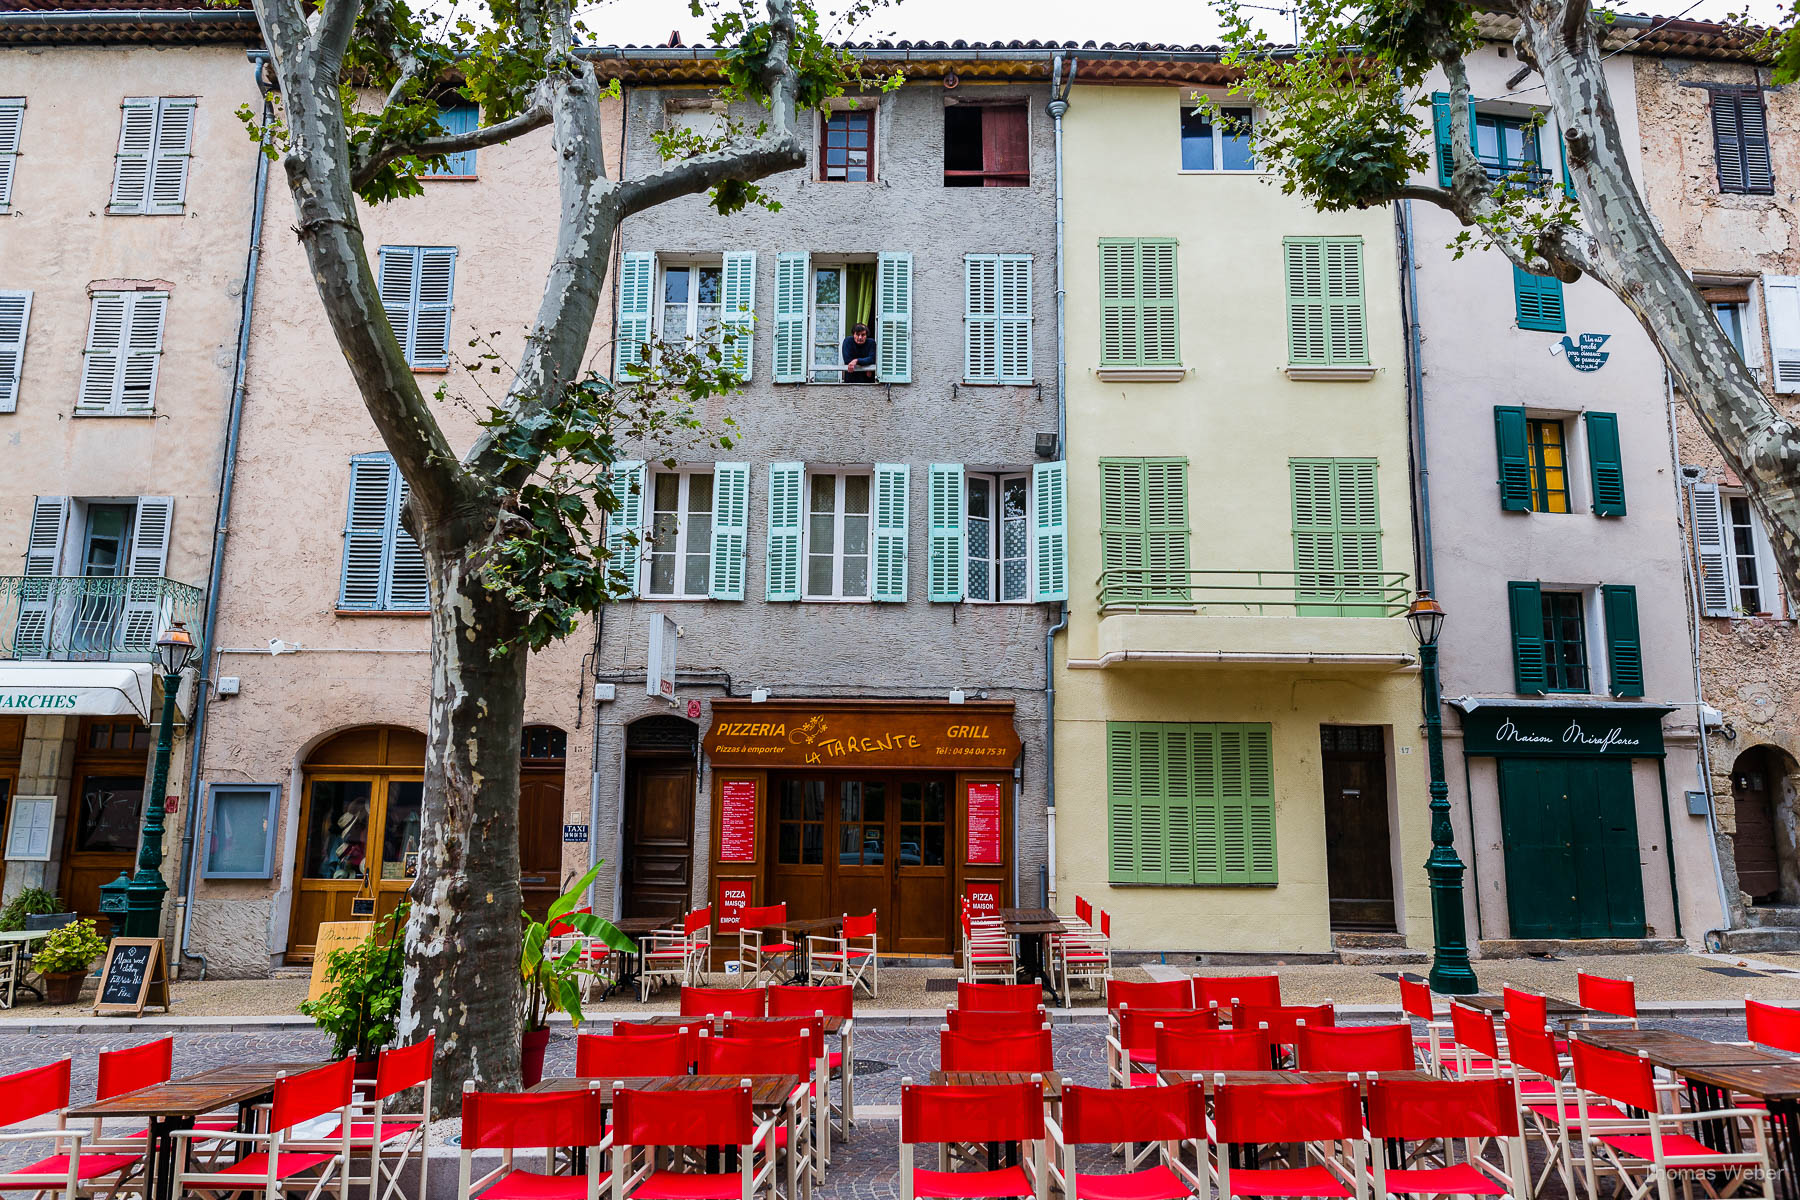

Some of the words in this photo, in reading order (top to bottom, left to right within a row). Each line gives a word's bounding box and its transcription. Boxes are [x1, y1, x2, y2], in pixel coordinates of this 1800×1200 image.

[0, 694, 78, 709] ARCHES
[716, 723, 786, 737] PIZZERIA
[947, 725, 990, 739] GRILL
[1496, 716, 1553, 743] Maison
[1562, 719, 1640, 753] Miraflores
[715, 744, 741, 753] Pizzas
[741, 744, 747, 753] à
[747, 745, 785, 755] emporter
[805, 751, 822, 765] LA
[817, 732, 921, 758] TARENTE
[952, 747, 962, 755] 04
[963, 747, 974, 756] 94
[974, 747, 985, 756] 04
[724, 890, 746, 899] PIZZA
[972, 893, 994, 902] PIZZA
